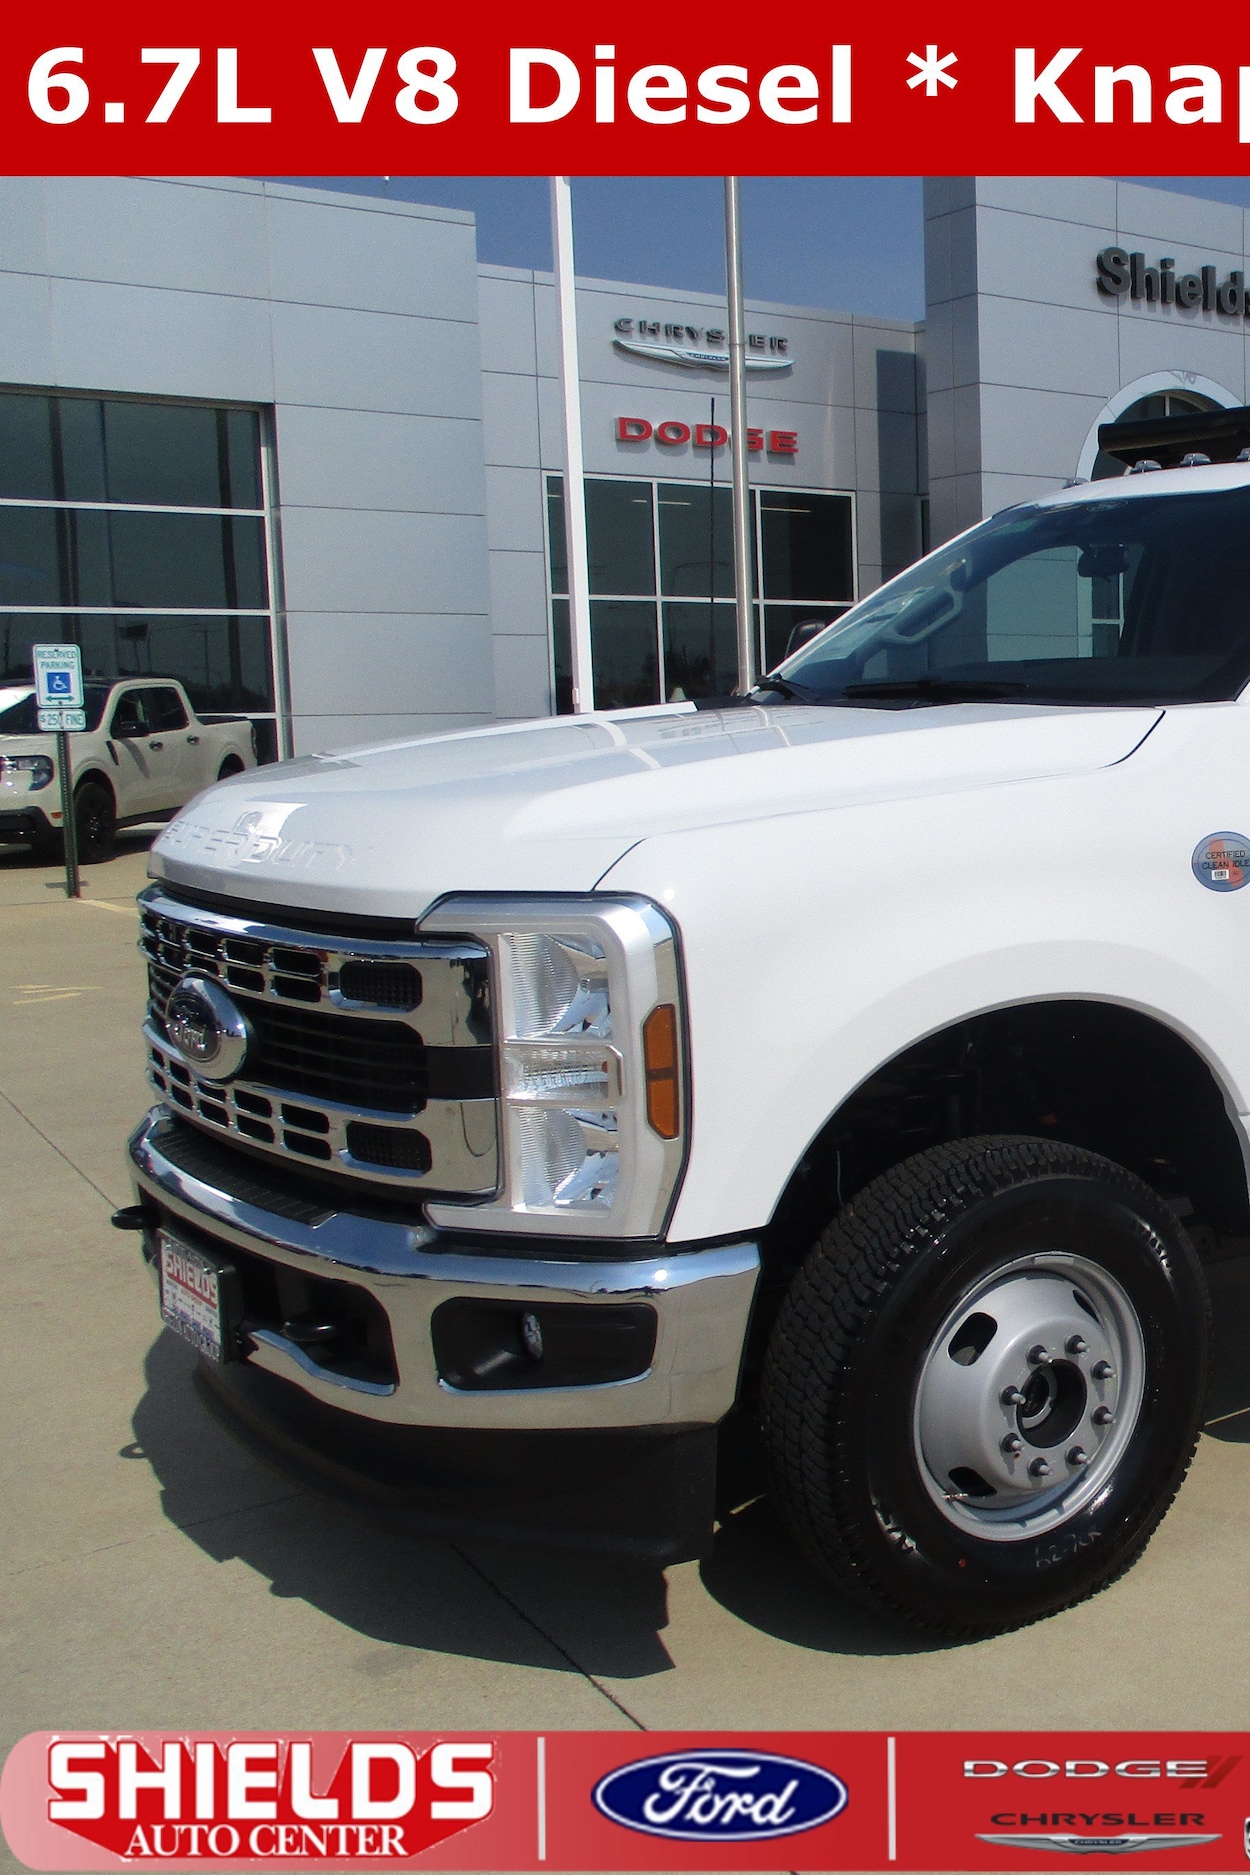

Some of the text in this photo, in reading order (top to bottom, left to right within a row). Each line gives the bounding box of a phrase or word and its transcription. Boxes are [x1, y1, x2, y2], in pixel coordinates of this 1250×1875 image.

[614, 318, 788, 350] CHRYSER
[36, 650, 76, 659] RESERVED
[40, 661, 75, 670] PARKING
[66, 713, 84, 726] FINE
[1205, 849, 1246, 860] CERTIFIED
[1201, 859, 1250, 870] CLEAN IDLE
[165, 1250, 218, 1304] SHIELDS
